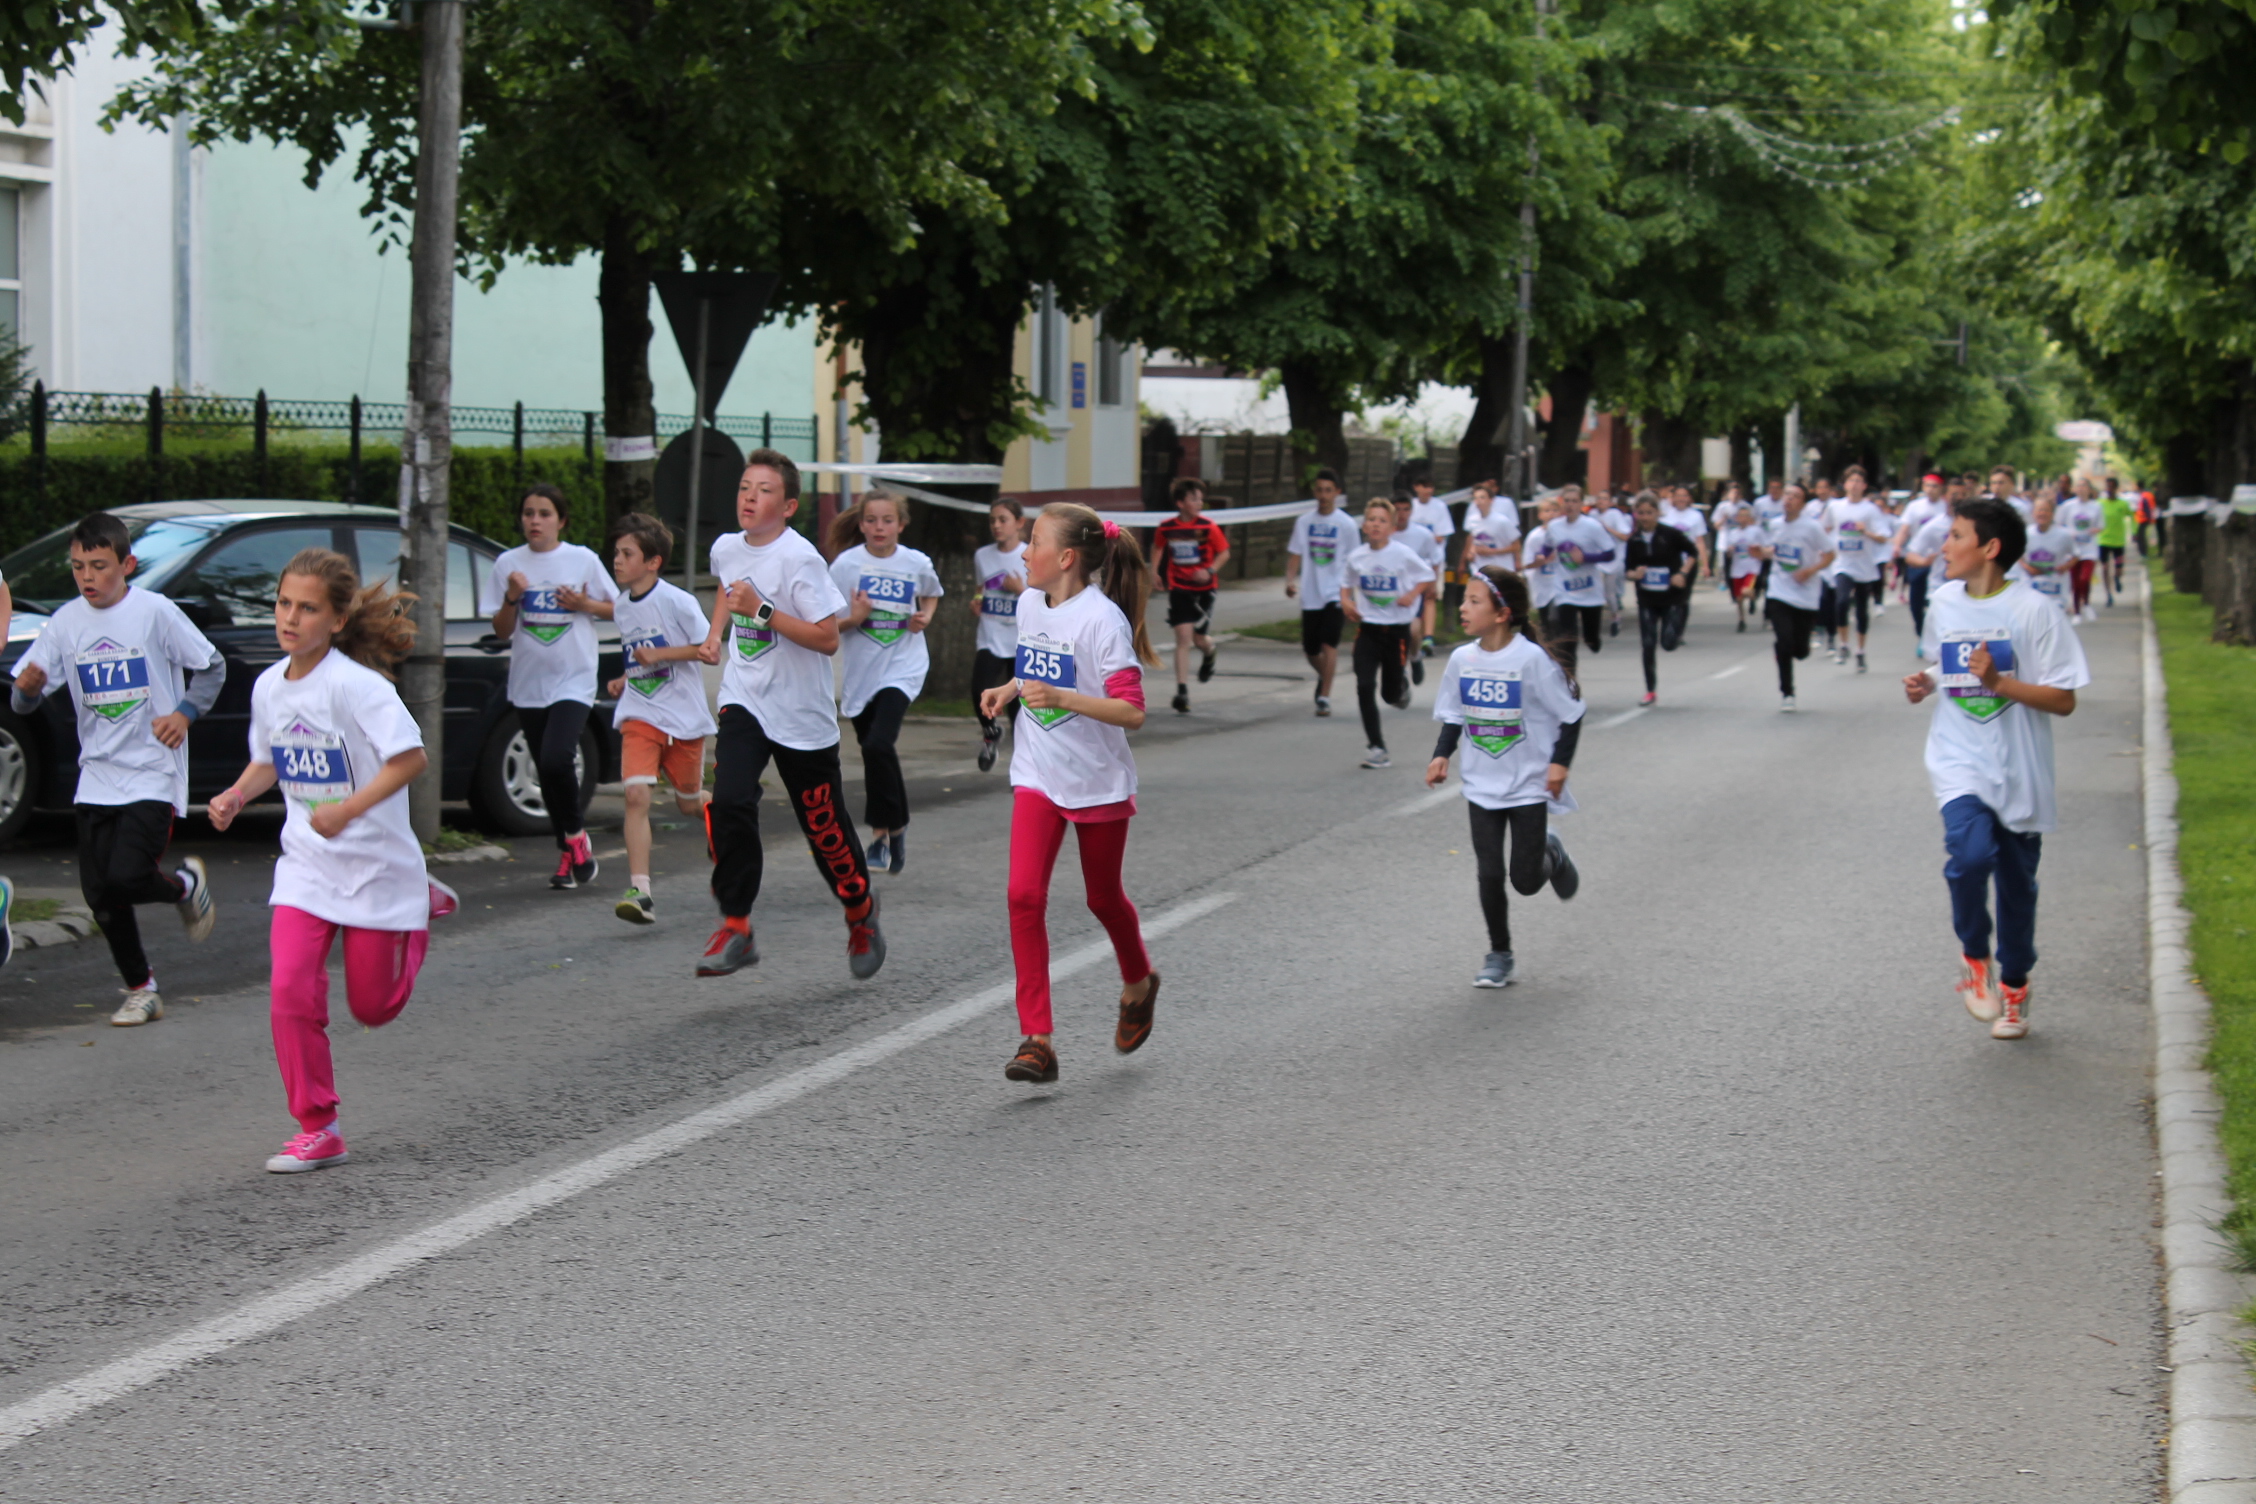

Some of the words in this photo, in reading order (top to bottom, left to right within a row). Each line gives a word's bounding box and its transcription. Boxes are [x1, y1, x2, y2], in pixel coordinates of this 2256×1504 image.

[867, 576, 905, 599] 283
[532, 591, 567, 610] 43
[986, 599, 1013, 614] 198
[735, 625, 758, 639] UNFEST
[88, 660, 131, 687] 171
[1023, 648, 1062, 680] 255
[1467, 679, 1509, 704] 458
[283, 746, 331, 779] 348
[801, 782, 867, 899] adidas
